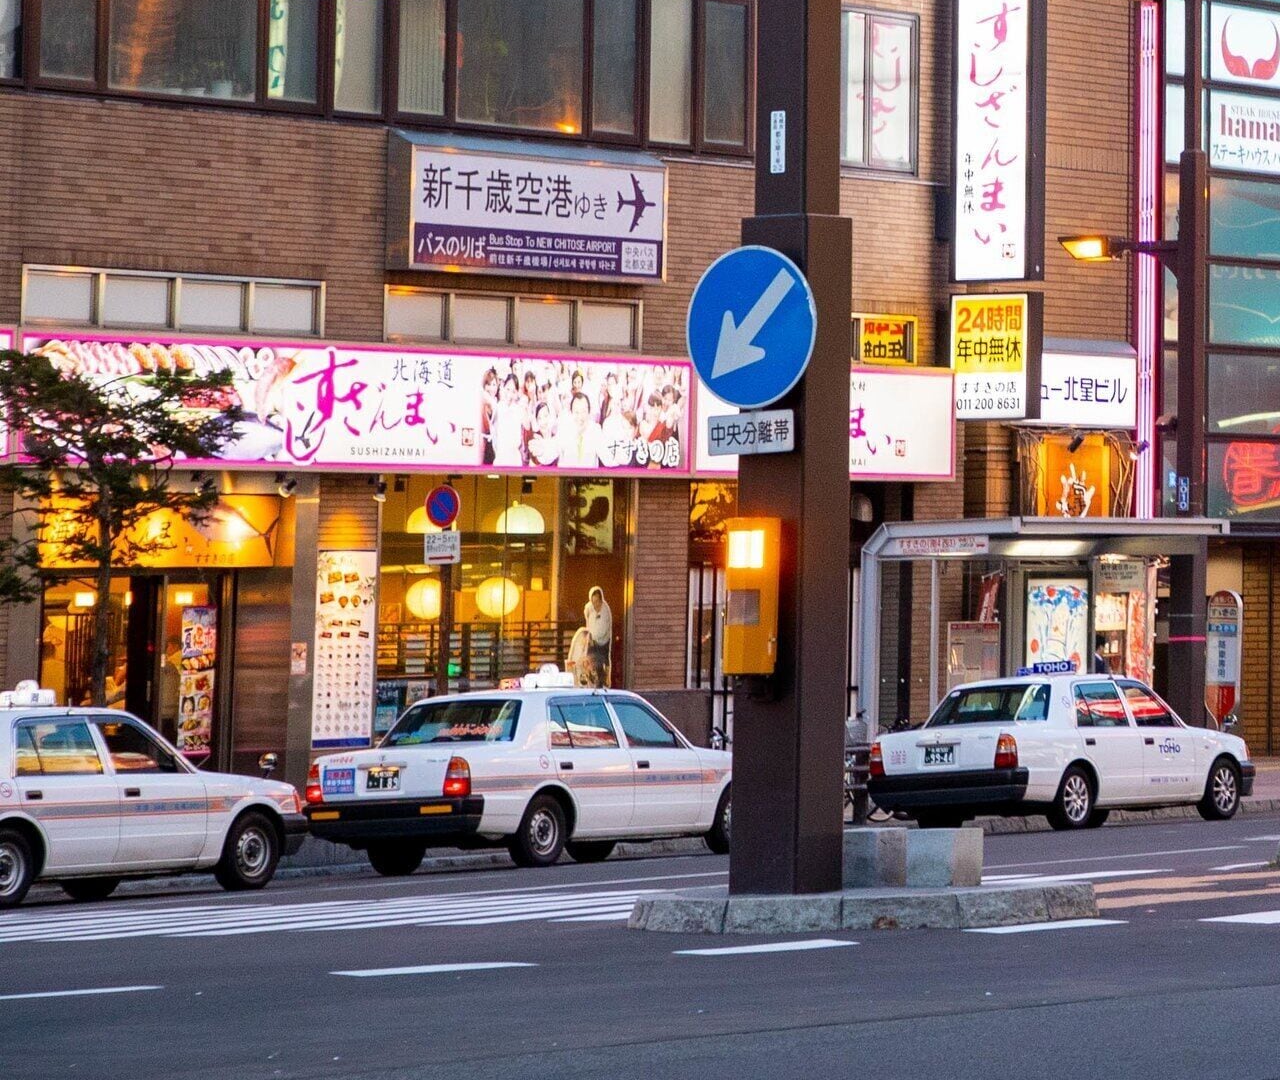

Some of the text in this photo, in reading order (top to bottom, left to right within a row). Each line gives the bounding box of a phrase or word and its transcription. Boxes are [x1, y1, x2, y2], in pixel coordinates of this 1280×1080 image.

[969, 2, 1022, 246] すしざんまい
[1220, 103, 1280, 142] hama
[1231, 105, 1280, 121] STEAK HOUSE
[1212, 143, 1271, 165] ステーキハウス
[422, 163, 609, 220] 新千歳空港ゆき
[417, 231, 487, 260] バスのりば
[489, 232, 617, 253] Bus Stop To NEW CHITOSE AIRPORT
[625, 246, 655, 258] 中央バス
[957, 304, 1022, 334] 24時間
[957, 337, 1022, 363] 年中無休
[391, 357, 455, 389] 北海道
[961, 380, 1017, 393] すすきの店
[956, 397, 1021, 410] 011 200 8631
[710, 418, 790, 448] 中央分離帯
[350, 445, 426, 458] SUSHIZANMAI
[607, 438, 681, 469] すすきの店
[1036, 662, 1070, 673] TOHO
